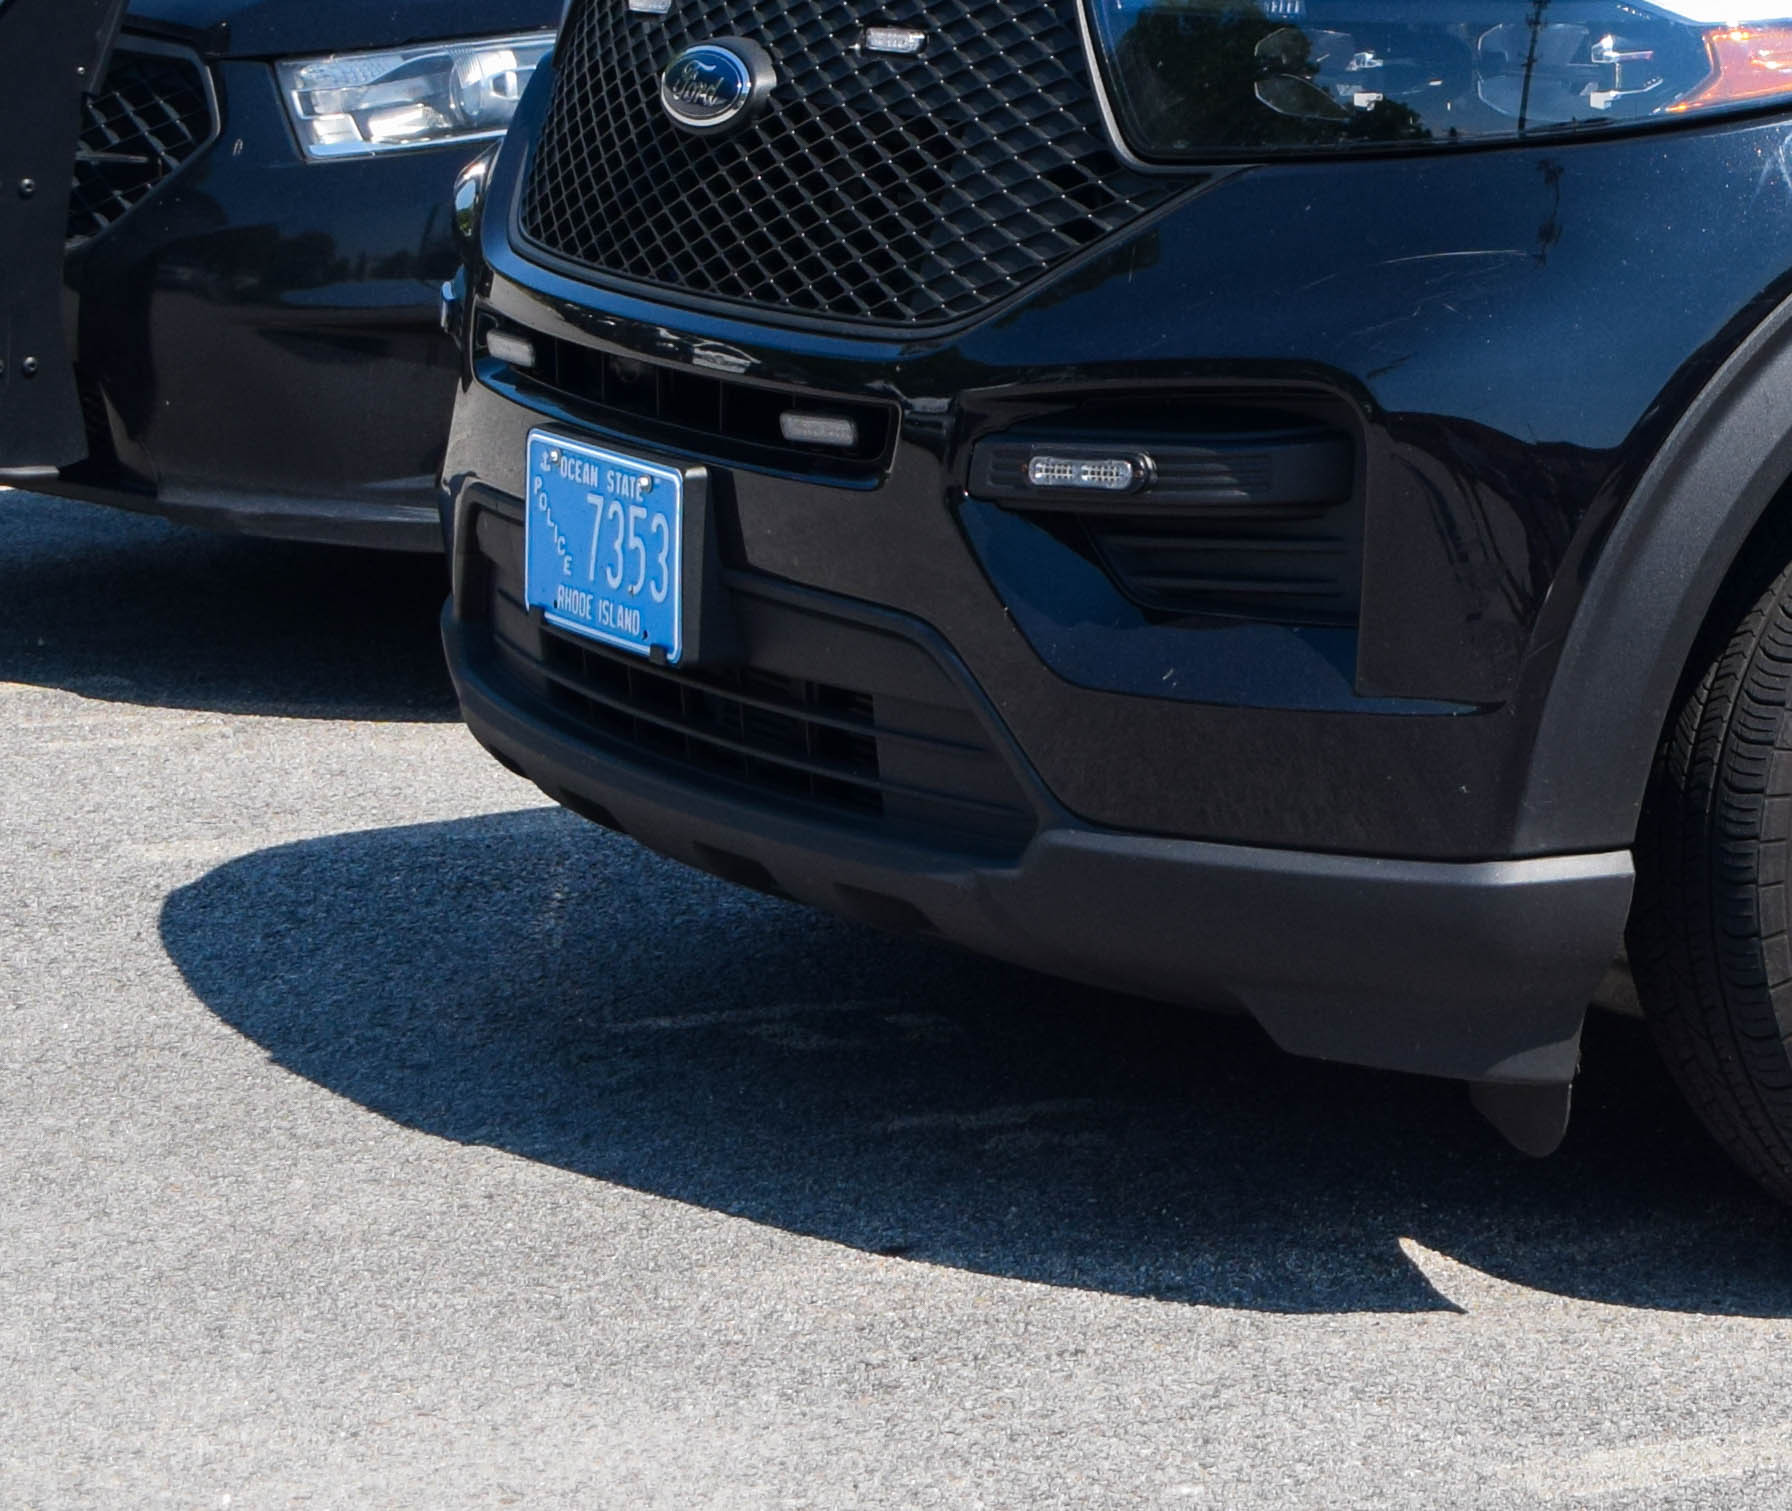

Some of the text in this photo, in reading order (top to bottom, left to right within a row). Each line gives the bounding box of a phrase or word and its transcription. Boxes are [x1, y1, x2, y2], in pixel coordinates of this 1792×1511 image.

[560, 455, 644, 503] OCEAN STATE
[533, 475, 573, 576] POLICE
[586, 492, 669, 603] 7353
[556, 584, 640, 636] RHODE ISLAND
